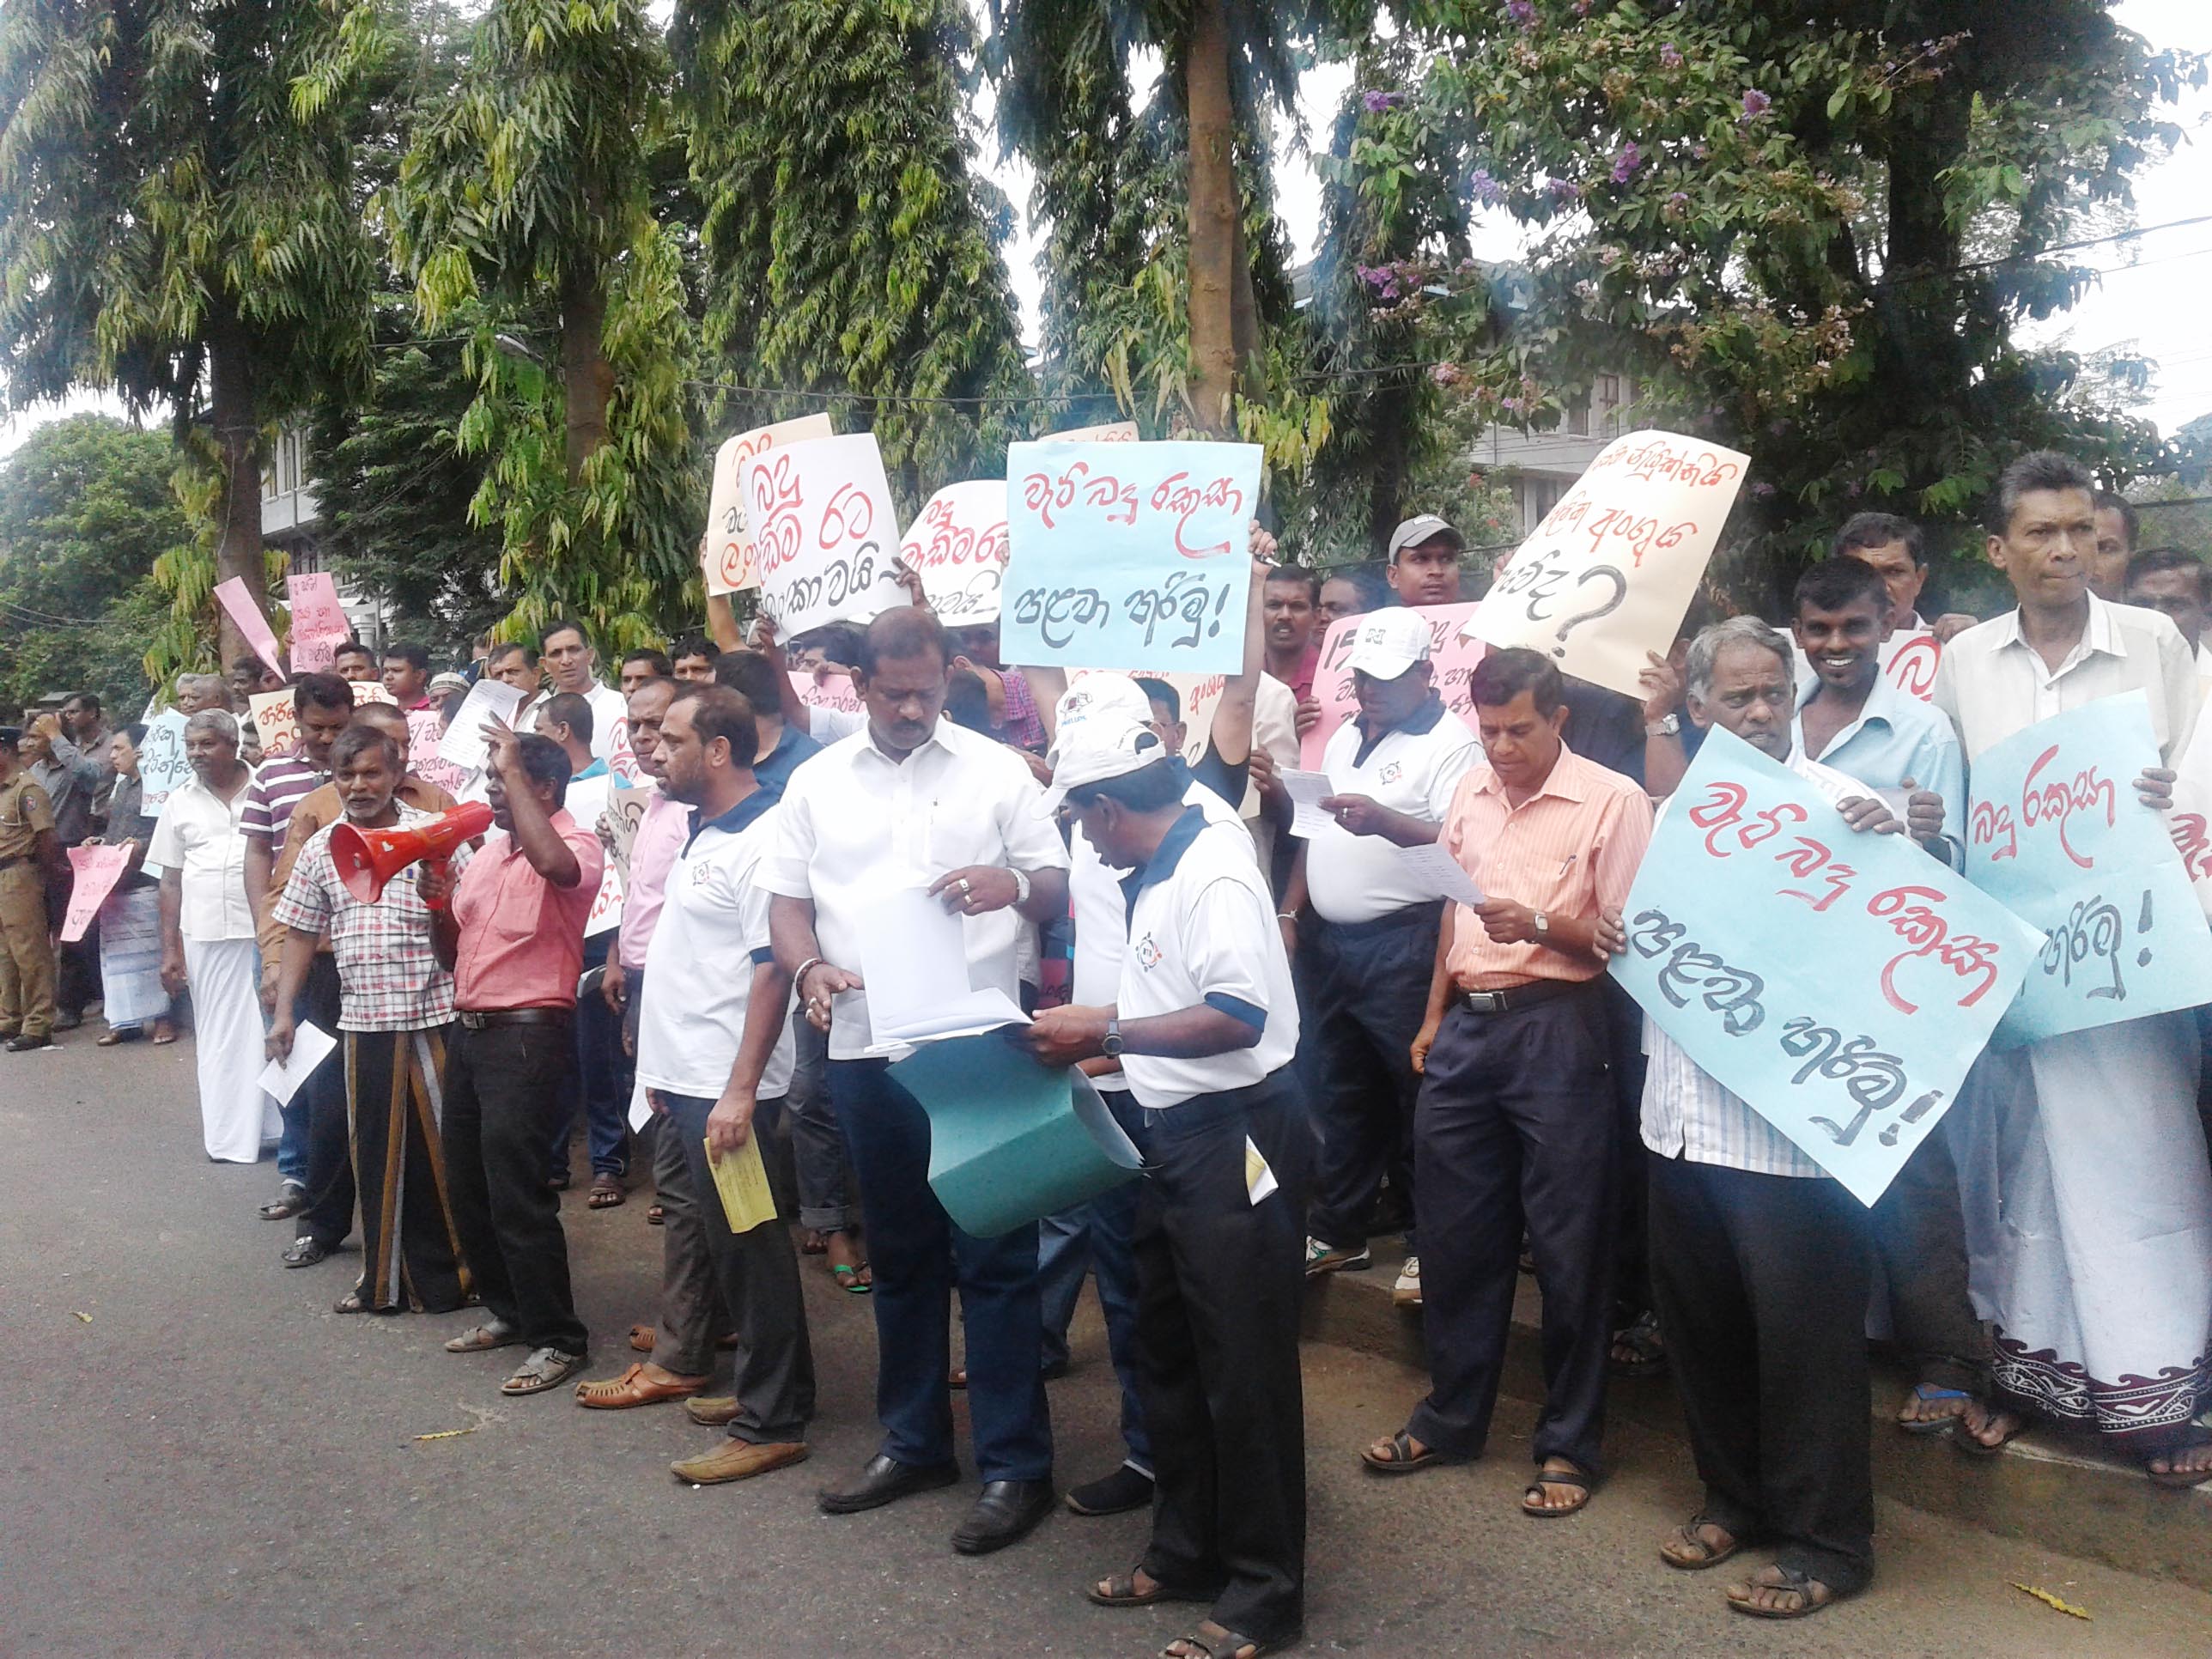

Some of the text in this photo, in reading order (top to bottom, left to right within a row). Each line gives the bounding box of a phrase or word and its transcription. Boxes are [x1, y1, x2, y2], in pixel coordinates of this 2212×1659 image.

[819, 482, 873, 550] රට
[1083, 477, 1139, 525] බදු
[1775, 836, 1857, 911] බදු
